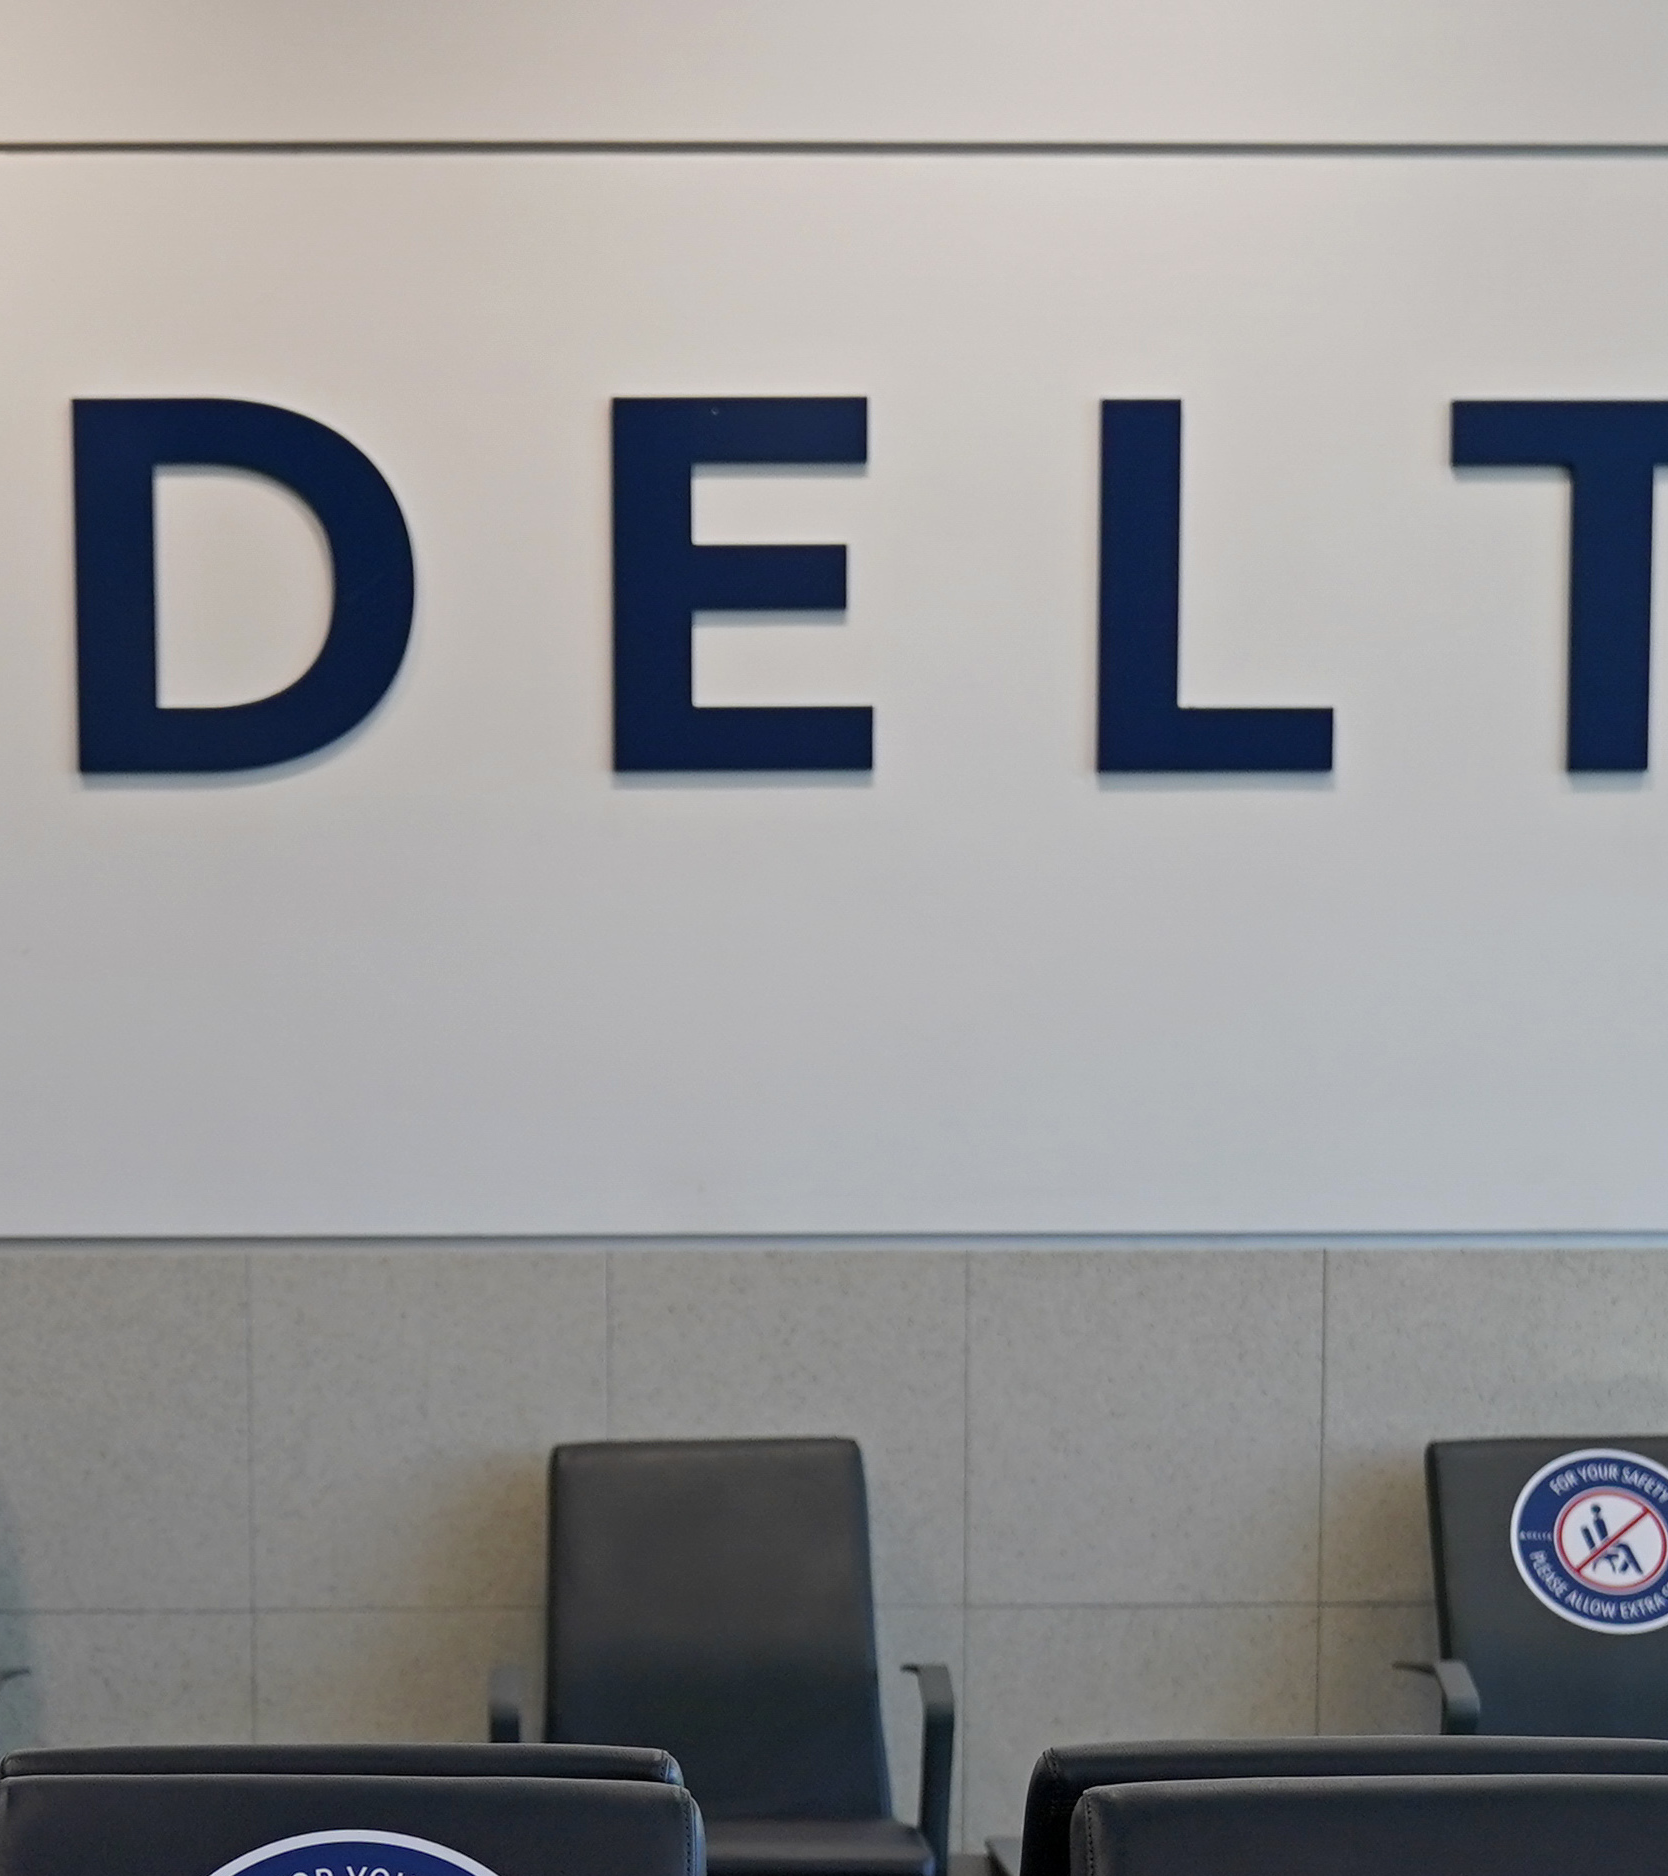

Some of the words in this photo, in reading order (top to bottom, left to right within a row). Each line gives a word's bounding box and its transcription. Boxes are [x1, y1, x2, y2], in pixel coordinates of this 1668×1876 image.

[1549, 1473, 1579, 1497] FOR
[1579, 1463, 1619, 1482] YOUR
[1529, 1550, 1566, 1598] PLEASE
[1565, 1591, 1616, 1618] ALLOW
[1620, 1594, 1666, 1619] EXTRA
